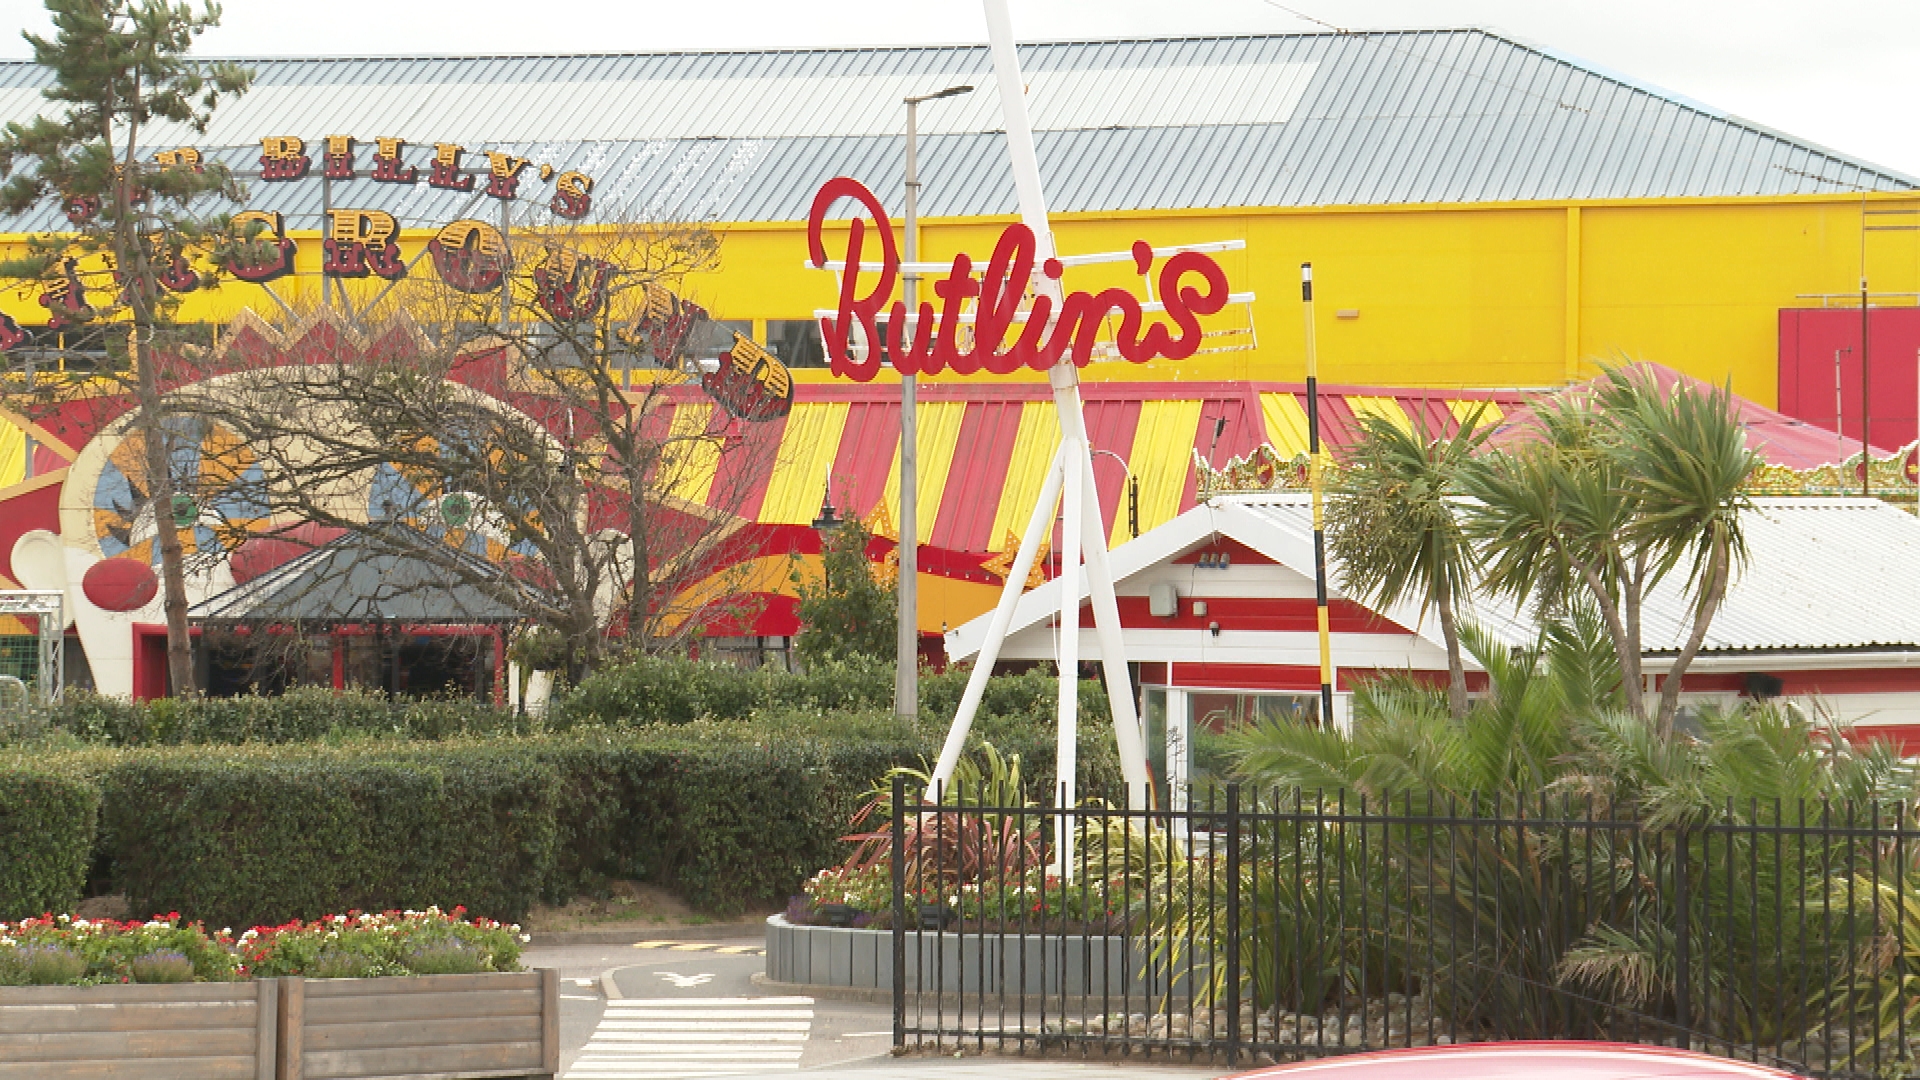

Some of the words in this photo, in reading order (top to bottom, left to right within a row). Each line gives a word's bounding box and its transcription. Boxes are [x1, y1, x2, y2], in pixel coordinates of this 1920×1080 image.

[259, 134, 594, 219] BILLY'S
[807, 176, 1230, 383] Butlin's
[0, 208, 794, 422] AGROUND
